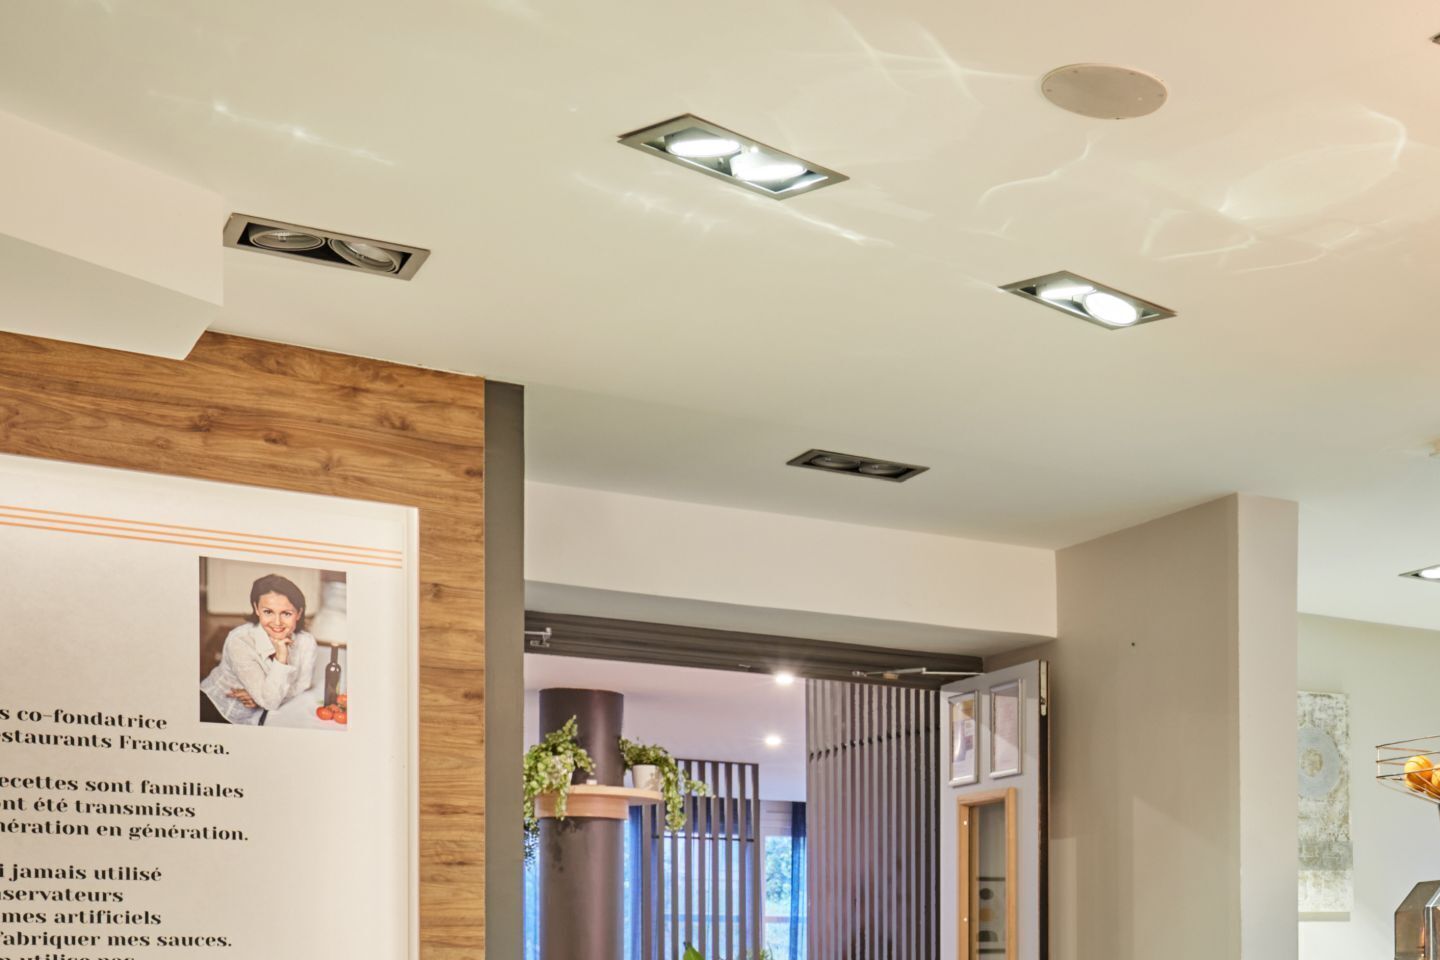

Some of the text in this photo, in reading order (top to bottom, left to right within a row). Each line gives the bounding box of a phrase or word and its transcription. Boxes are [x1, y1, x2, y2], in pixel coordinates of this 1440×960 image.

[16, 708, 168, 730] co-fondatrice
[0, 730, 230, 755] staurants Francesca.
[84, 779, 134, 794] sont
[140, 779, 244, 799] familiales
[0, 797, 196, 818] nt été transmises
[95, 823, 122, 837] en
[128, 823, 249, 842] génération.
[9, 863, 88, 882] jamais
[93, 866, 163, 882] utilisé
[0, 888, 125, 903] servateurs
[1, 909, 163, 925] mes artificiels
[107, 934, 151, 948] mes
[156, 934, 233, 948] sauces.
